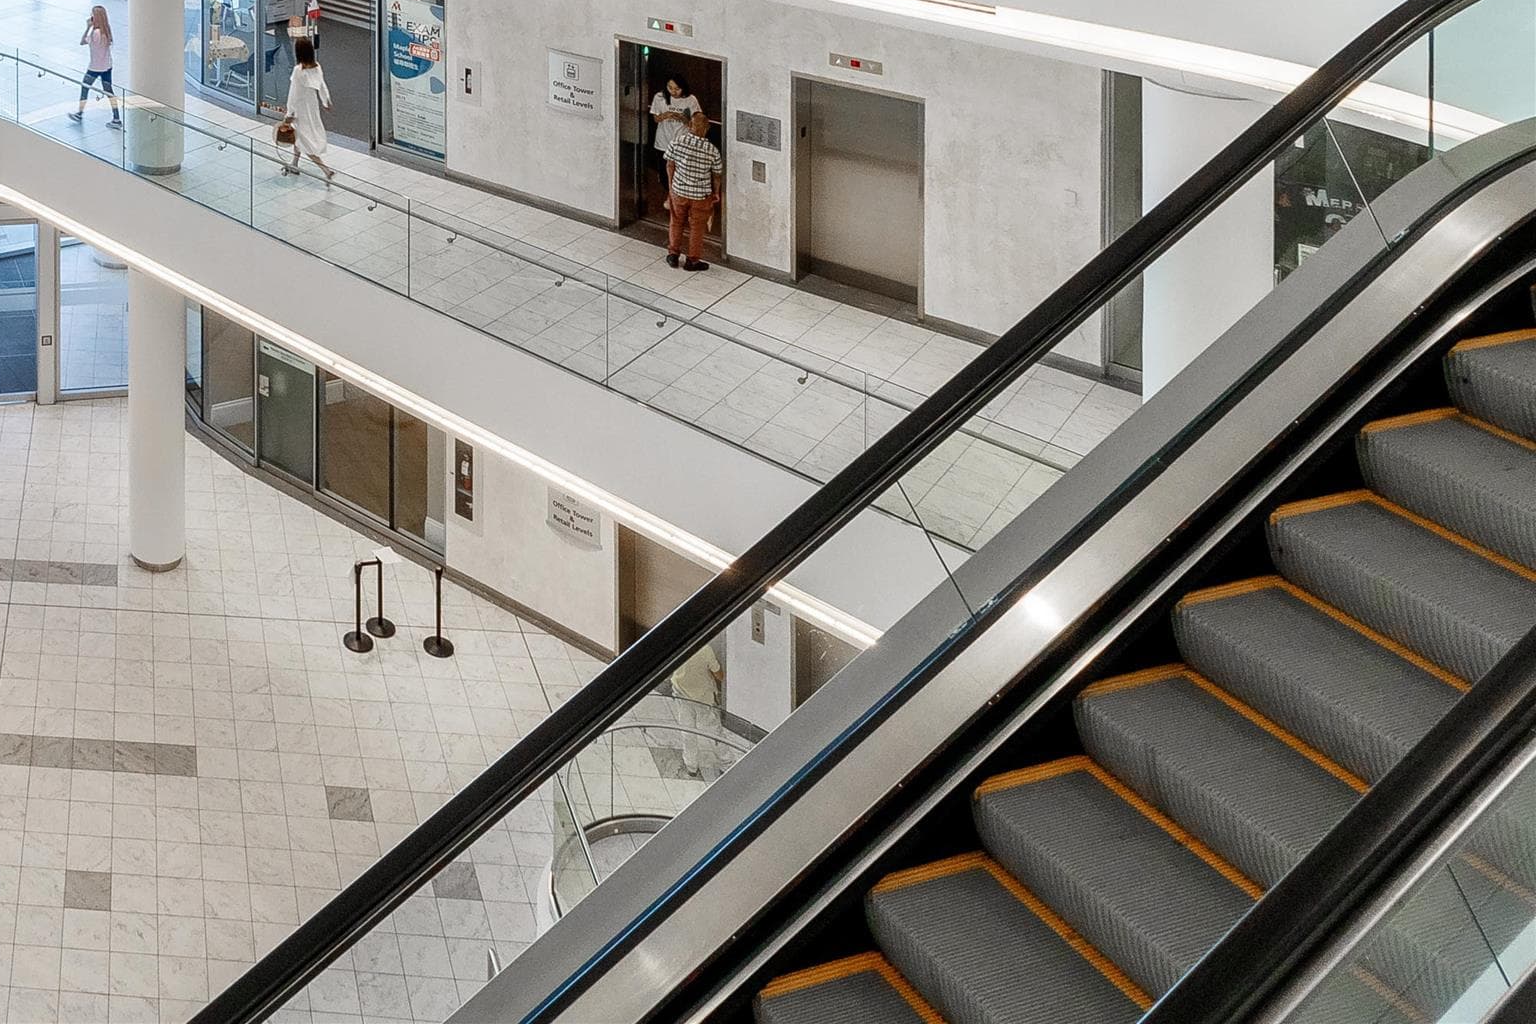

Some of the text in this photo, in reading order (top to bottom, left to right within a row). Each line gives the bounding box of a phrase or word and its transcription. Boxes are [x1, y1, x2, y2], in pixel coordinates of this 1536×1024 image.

[406, 21, 441, 38] EXAM
[553, 80, 595, 95] Office Tower
[553, 94, 594, 109] Retail Levels
[553, 500, 594, 523] Office Tower
[553, 514, 593, 537] Retail Levels
